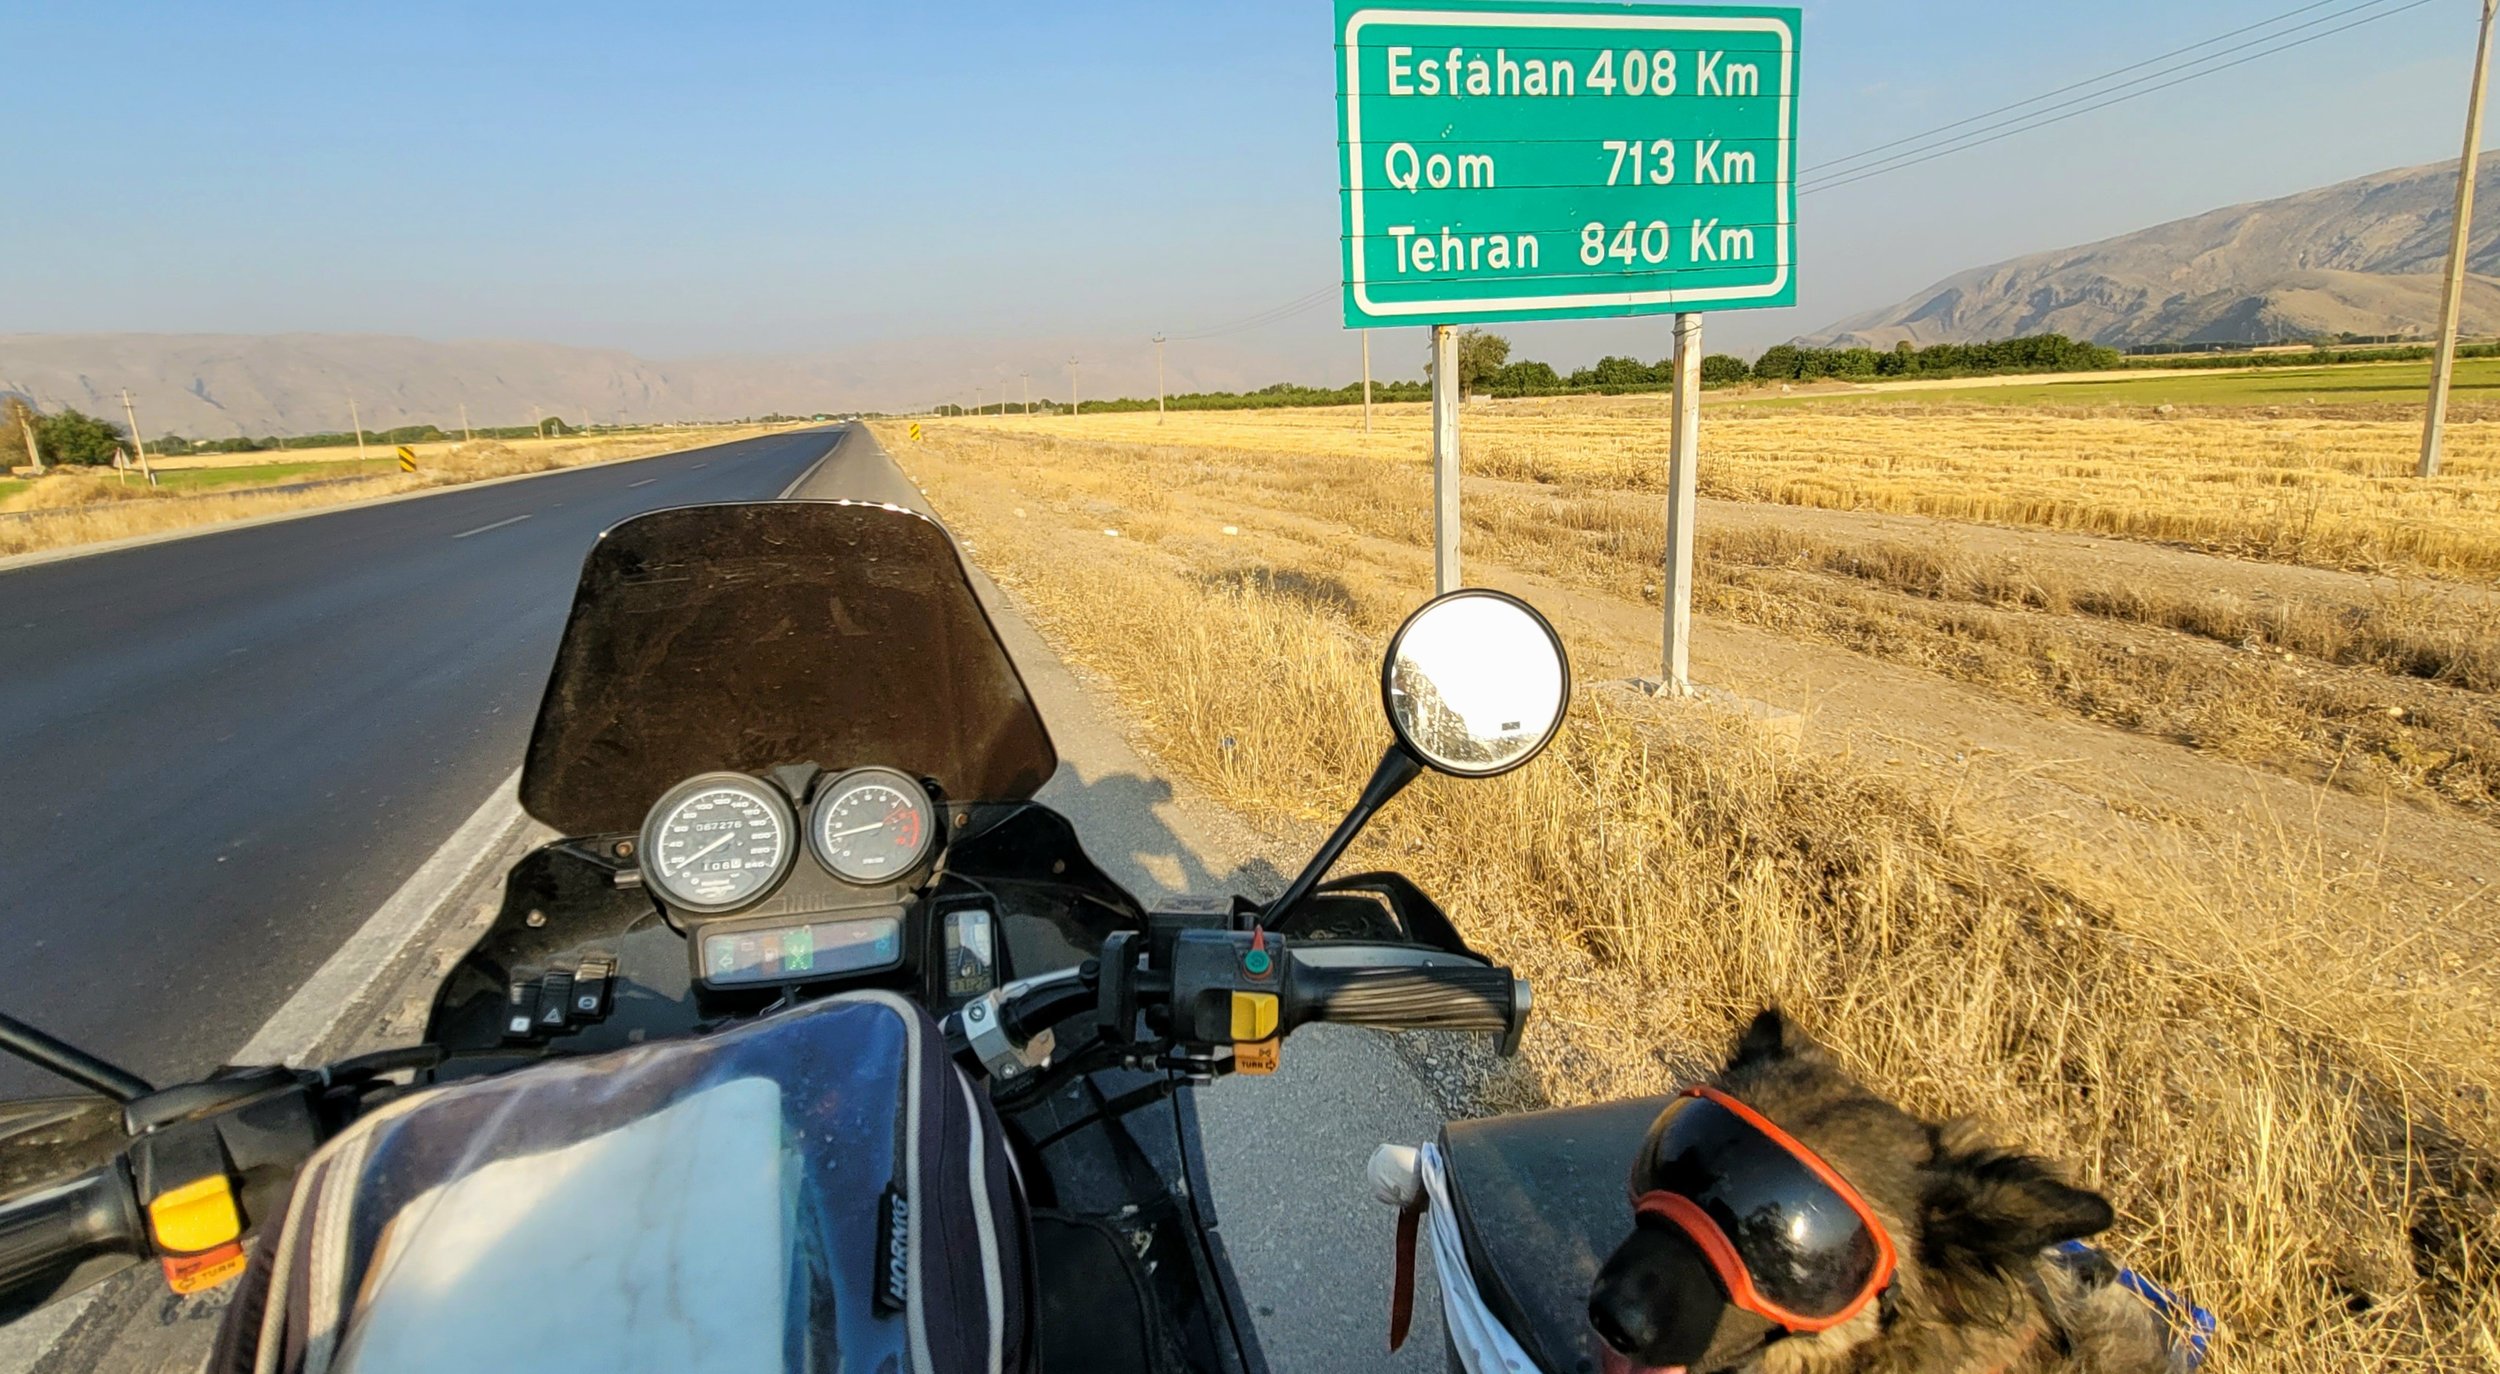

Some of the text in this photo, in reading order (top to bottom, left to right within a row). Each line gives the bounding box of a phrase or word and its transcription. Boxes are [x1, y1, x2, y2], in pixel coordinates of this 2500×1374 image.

[1388, 47, 1759, 96] Esfahan 408 Km
[1385, 139, 1756, 194] Qom 713 Km
[1389, 219, 1755, 273] Tehran 840 Km
[1241, 1060, 1263, 1069] TURN
[201, 1261, 236, 1280] TURN
